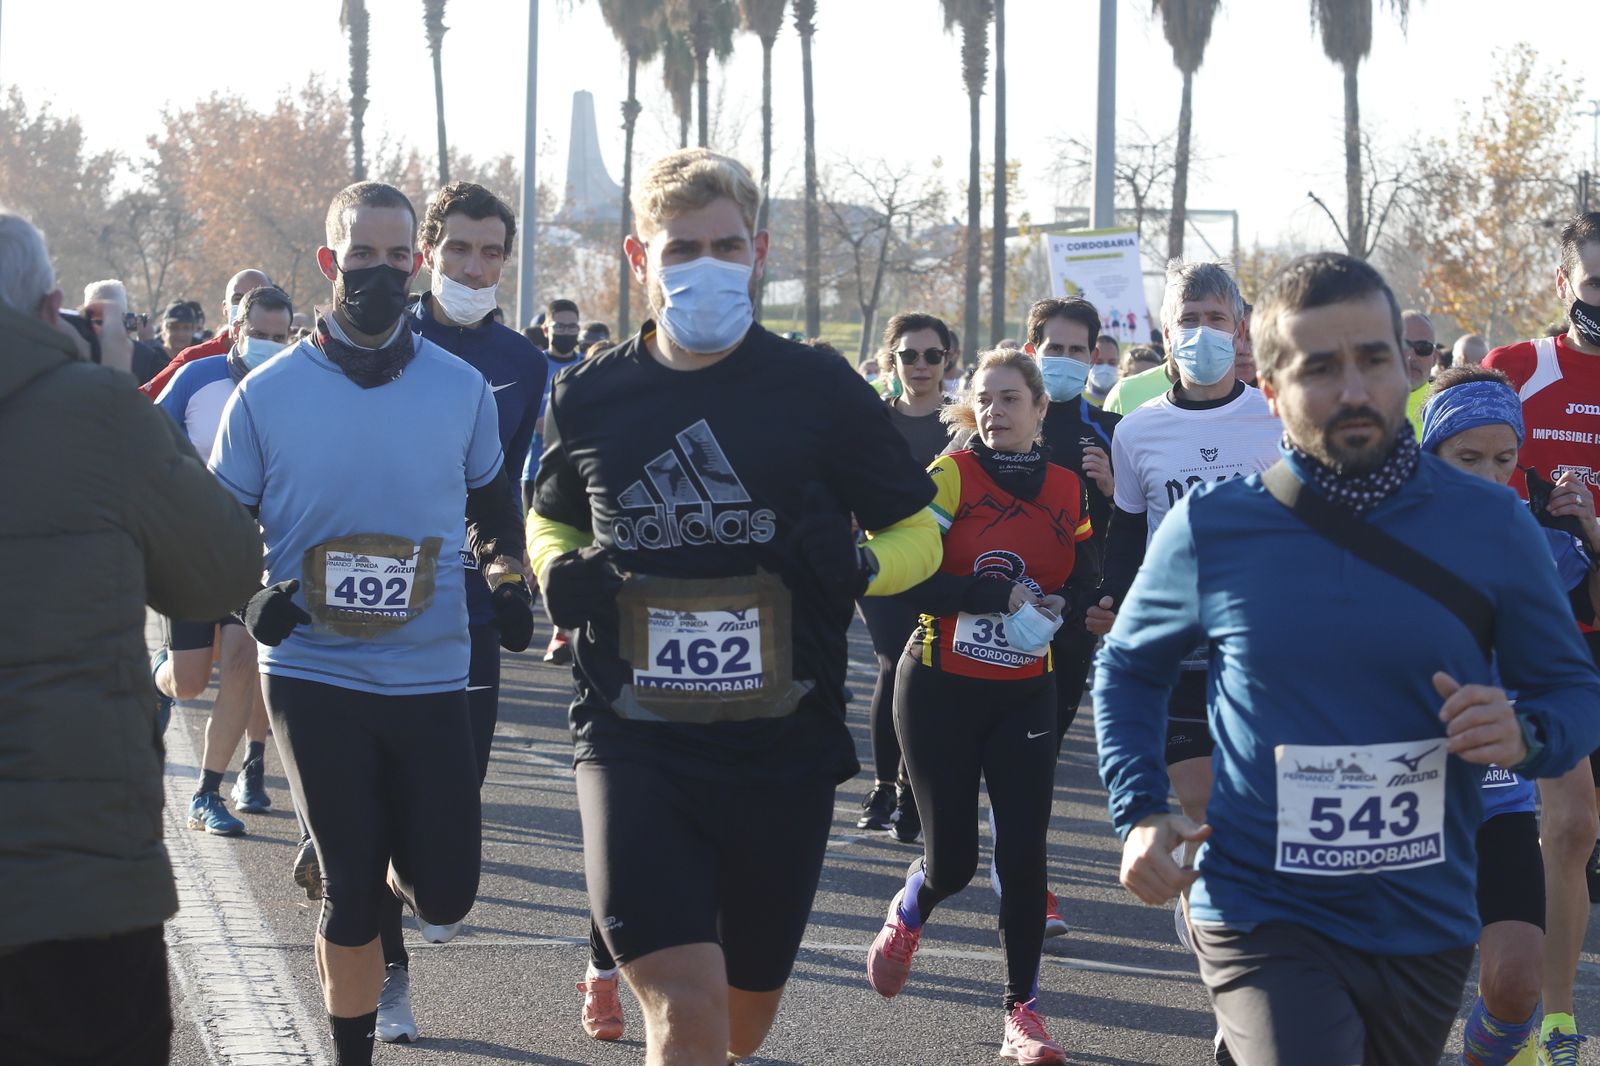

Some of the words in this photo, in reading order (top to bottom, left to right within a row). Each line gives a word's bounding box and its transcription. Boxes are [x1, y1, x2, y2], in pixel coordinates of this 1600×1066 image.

[1066, 238, 1135, 251] CORDOBARIA
[1532, 428, 1592, 444] IMPOSSIBLE
[1594, 434, 1600, 445] I
[611, 501, 776, 550] adidas
[334, 576, 407, 607] 492
[656, 636, 752, 676] 462
[957, 643, 970, 654] LA
[1283, 771, 1335, 783] FERNANDO
[1342, 773, 1378, 783] PINEDA
[1308, 791, 1420, 841] 543
[1285, 846, 1310, 864] LA
[1312, 838, 1438, 867] CORDOBARIA
